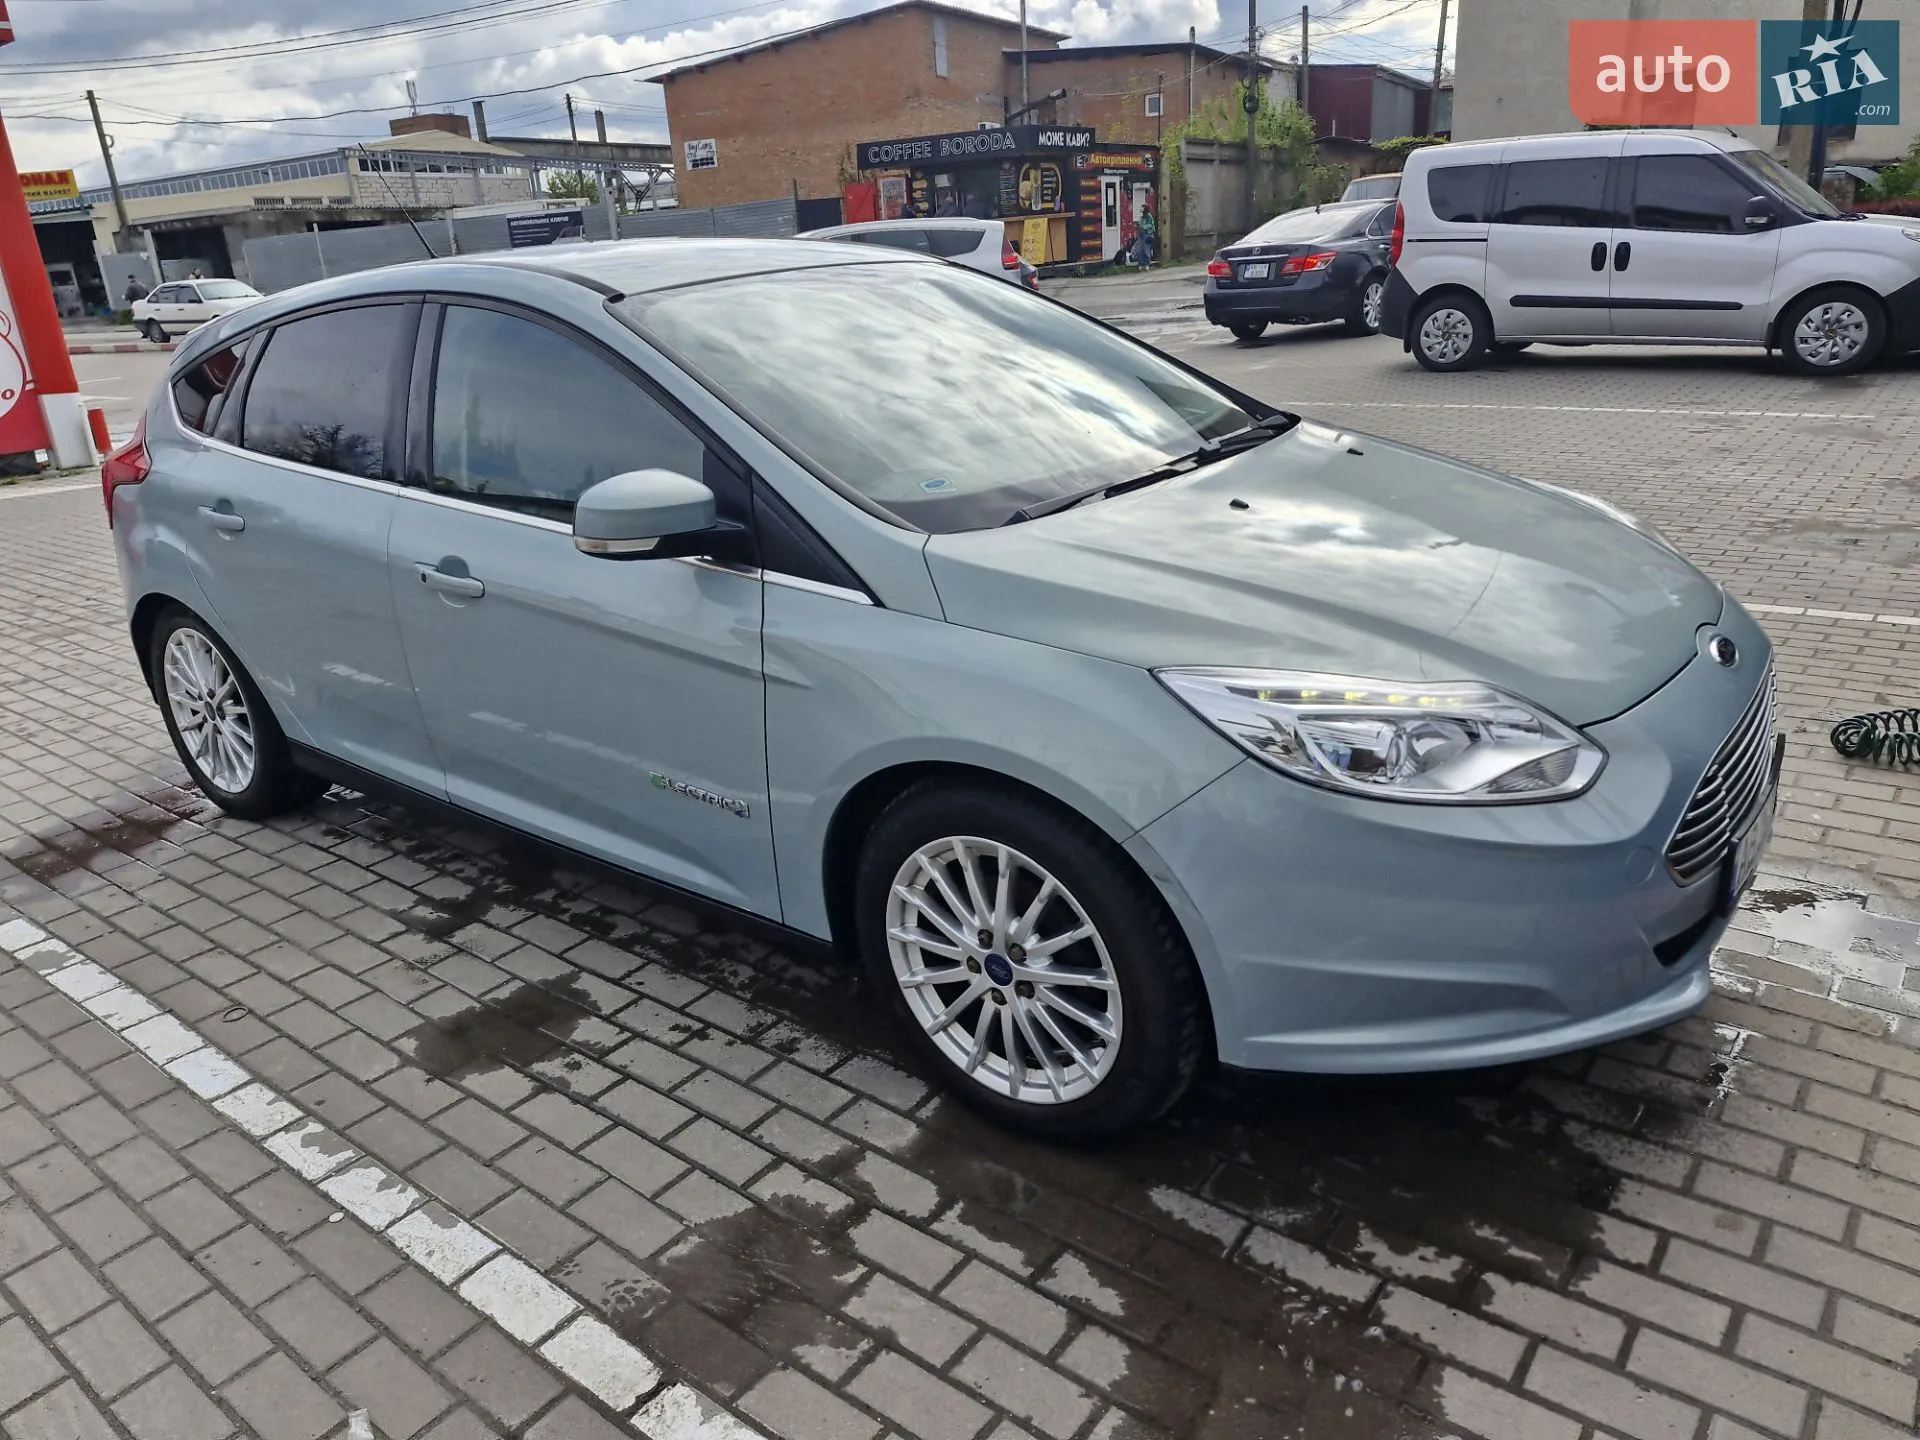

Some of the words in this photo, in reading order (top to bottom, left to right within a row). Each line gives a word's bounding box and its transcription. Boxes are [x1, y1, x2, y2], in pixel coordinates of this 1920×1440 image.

[868, 140, 932, 163] COFFEE
[939, 131, 1016, 157] BORODA
[1038, 131, 1064, 147] МОЖЕ
[1066, 132, 1090, 147] КАВИ?
[648, 770, 739, 812] ELECTRIC
